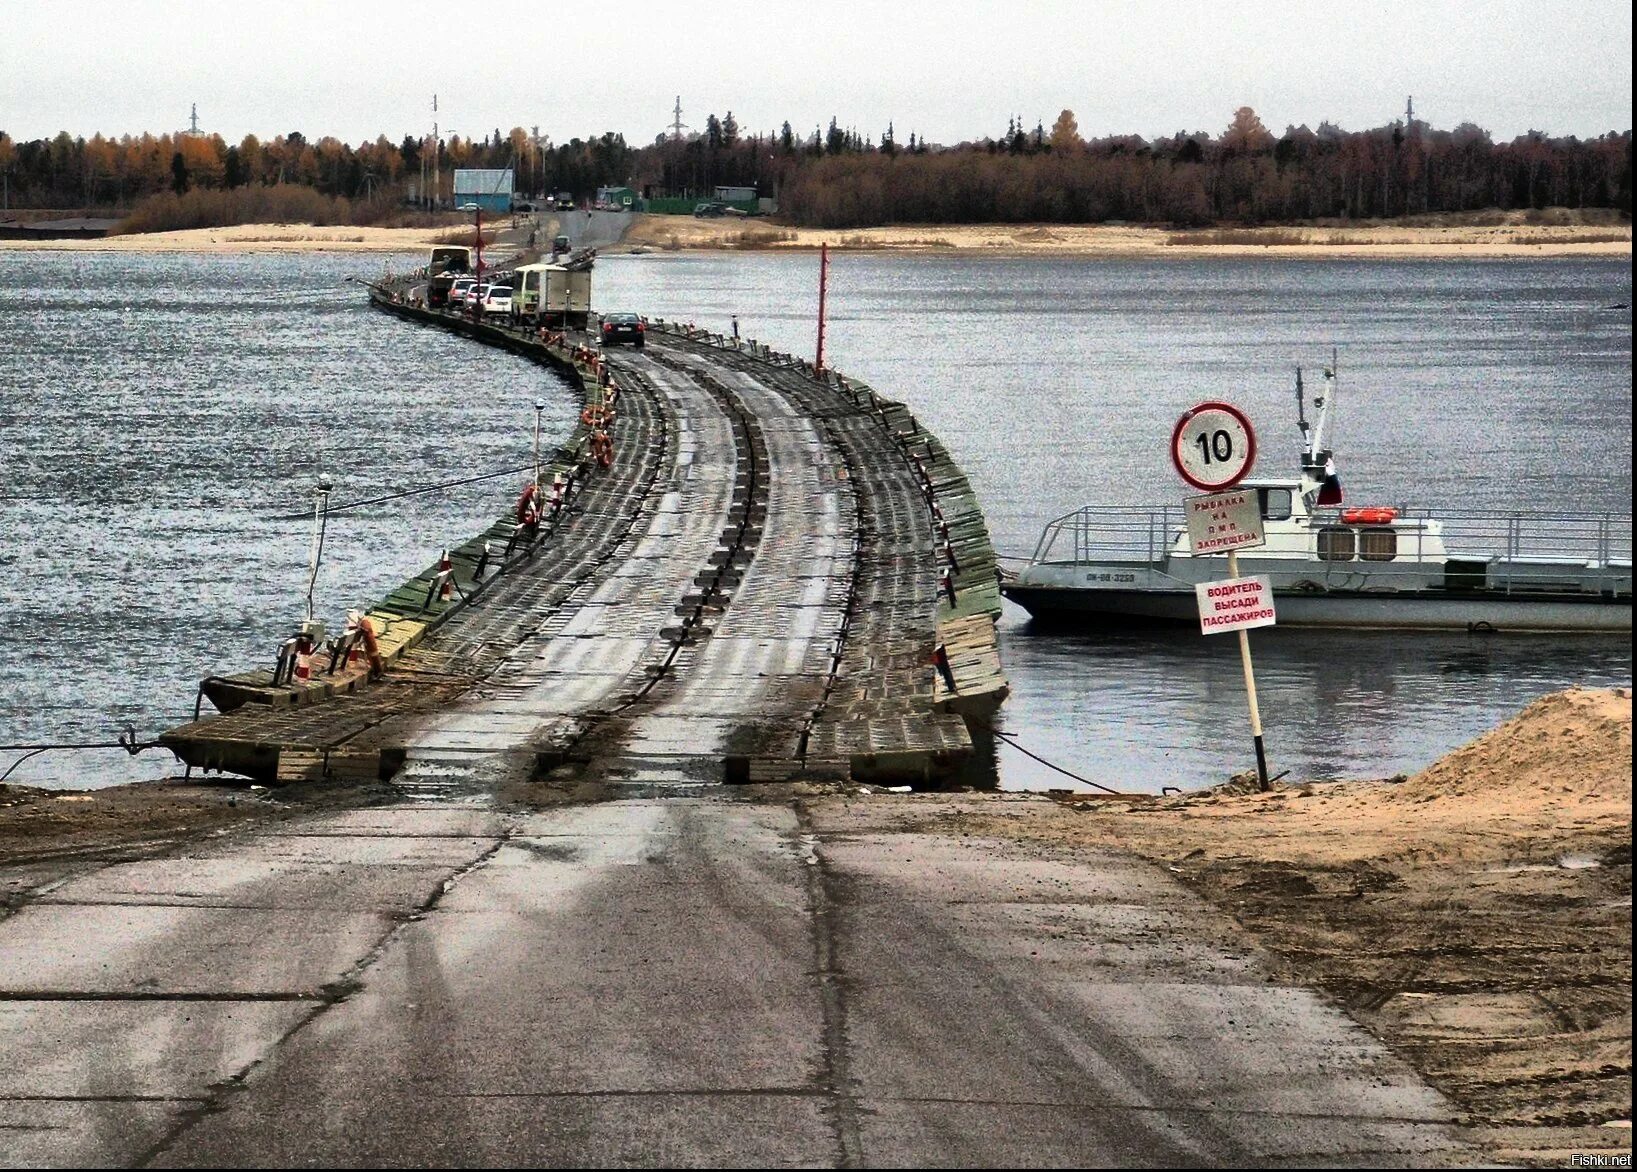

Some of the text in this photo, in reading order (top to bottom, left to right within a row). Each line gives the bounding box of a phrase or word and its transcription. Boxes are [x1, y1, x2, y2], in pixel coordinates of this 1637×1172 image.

[1197, 429, 1233, 465] 10
[1194, 498, 1245, 511] РЫБАЛКА
[1213, 512, 1227, 520] НА
[1197, 533, 1257, 549] ЗАПРЕЩЕНА
[1208, 582, 1262, 597] ВОДИТЕЛЬ
[1215, 597, 1259, 611] ВЫСАДИ
[1203, 609, 1274, 627] ПАССАЖИРОВ
